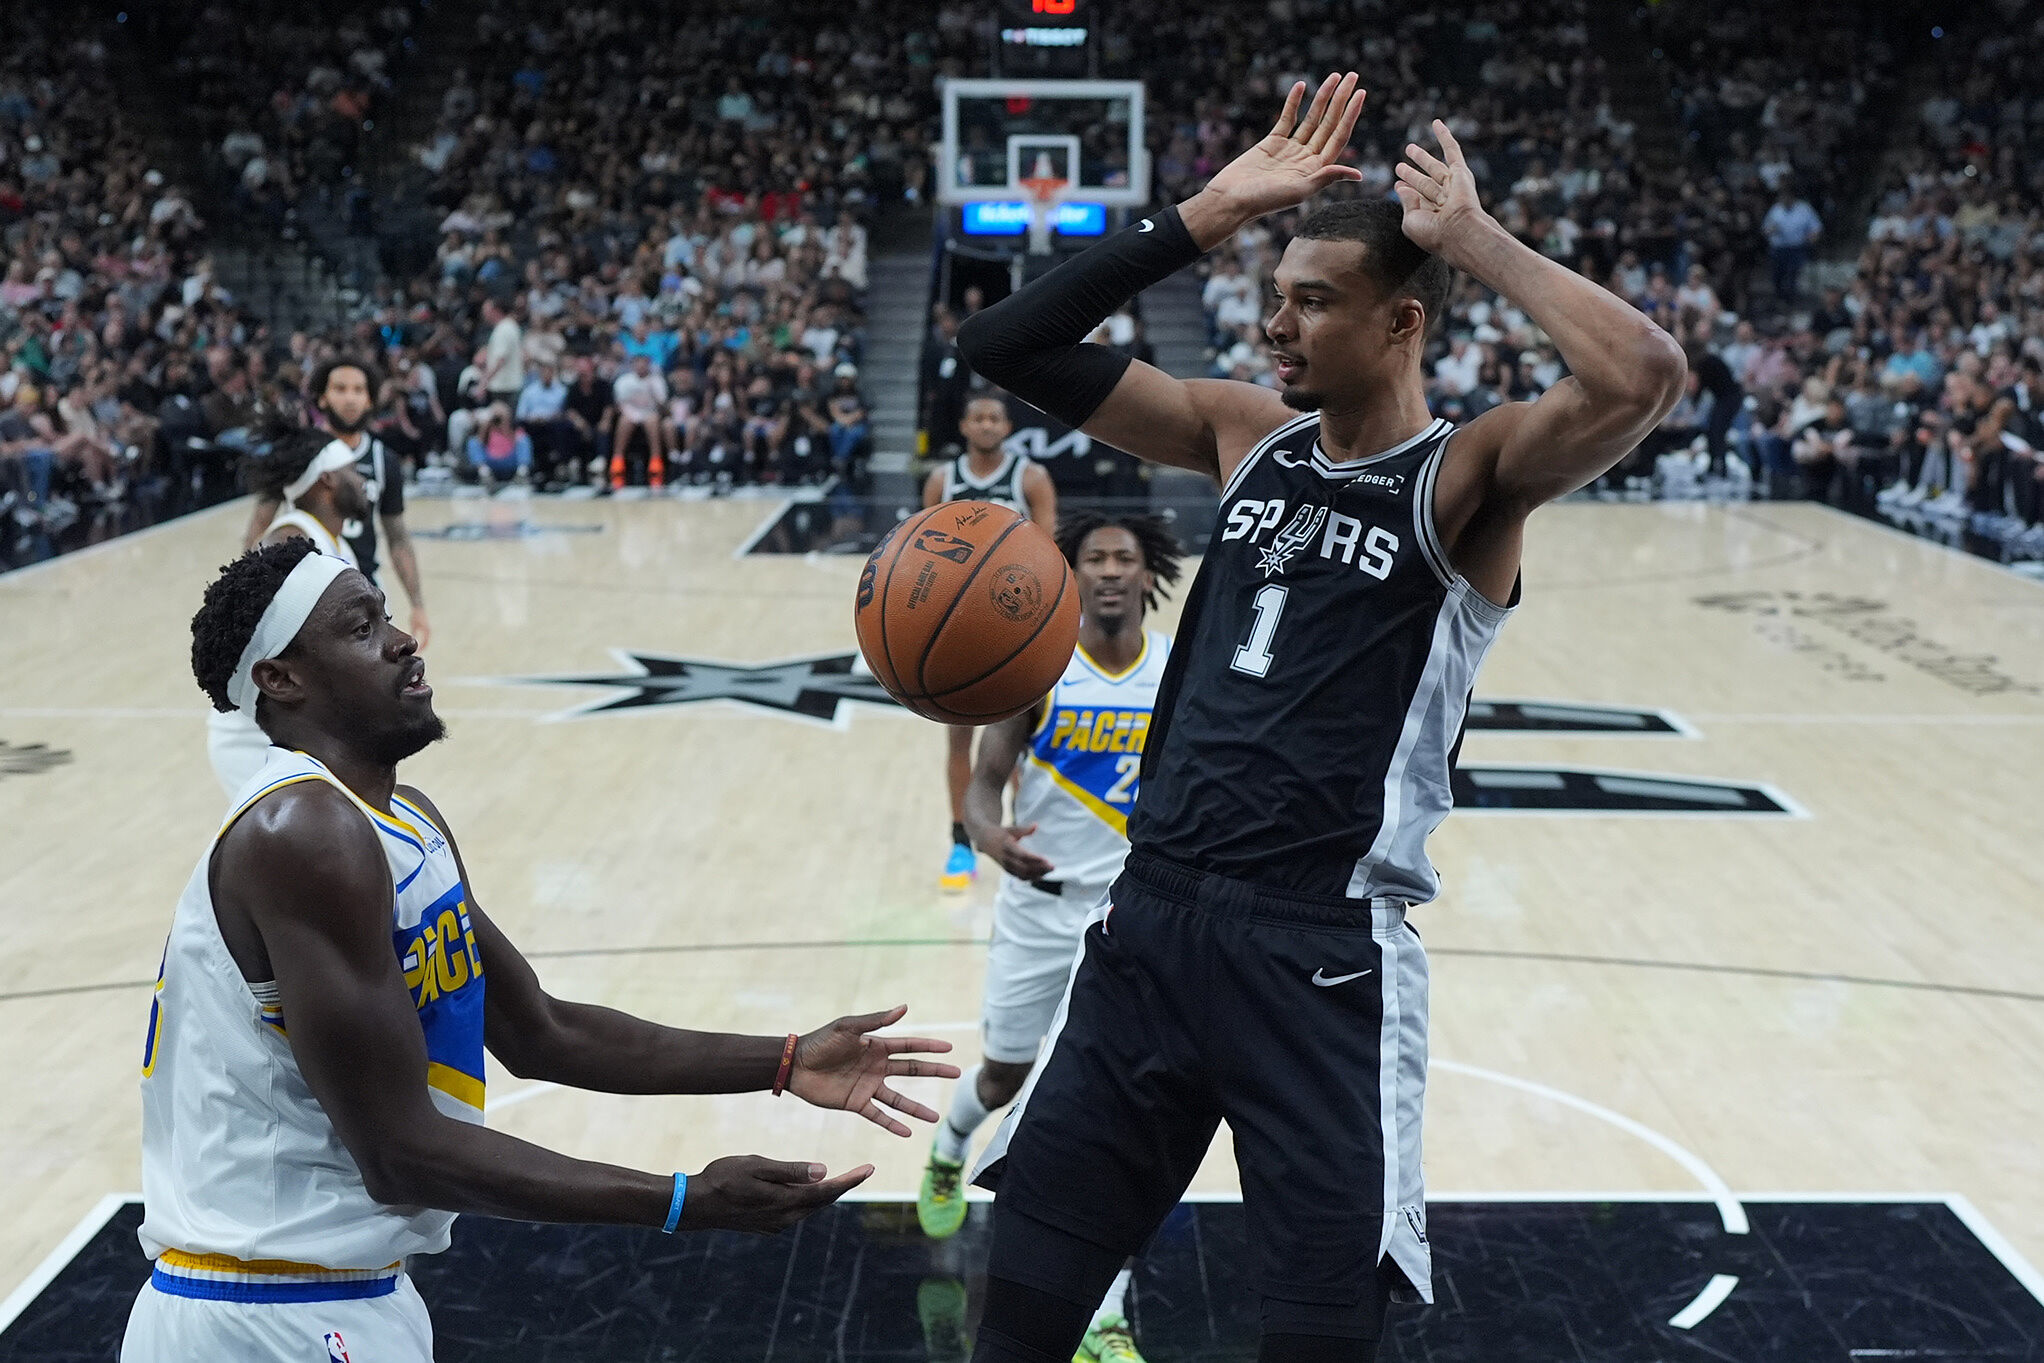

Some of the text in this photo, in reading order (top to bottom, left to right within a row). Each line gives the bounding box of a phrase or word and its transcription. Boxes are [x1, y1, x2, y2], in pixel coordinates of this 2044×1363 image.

[1222, 499, 1400, 581] SPURS
[1229, 582, 1290, 678] 1
[1104, 754, 1141, 803] 2
